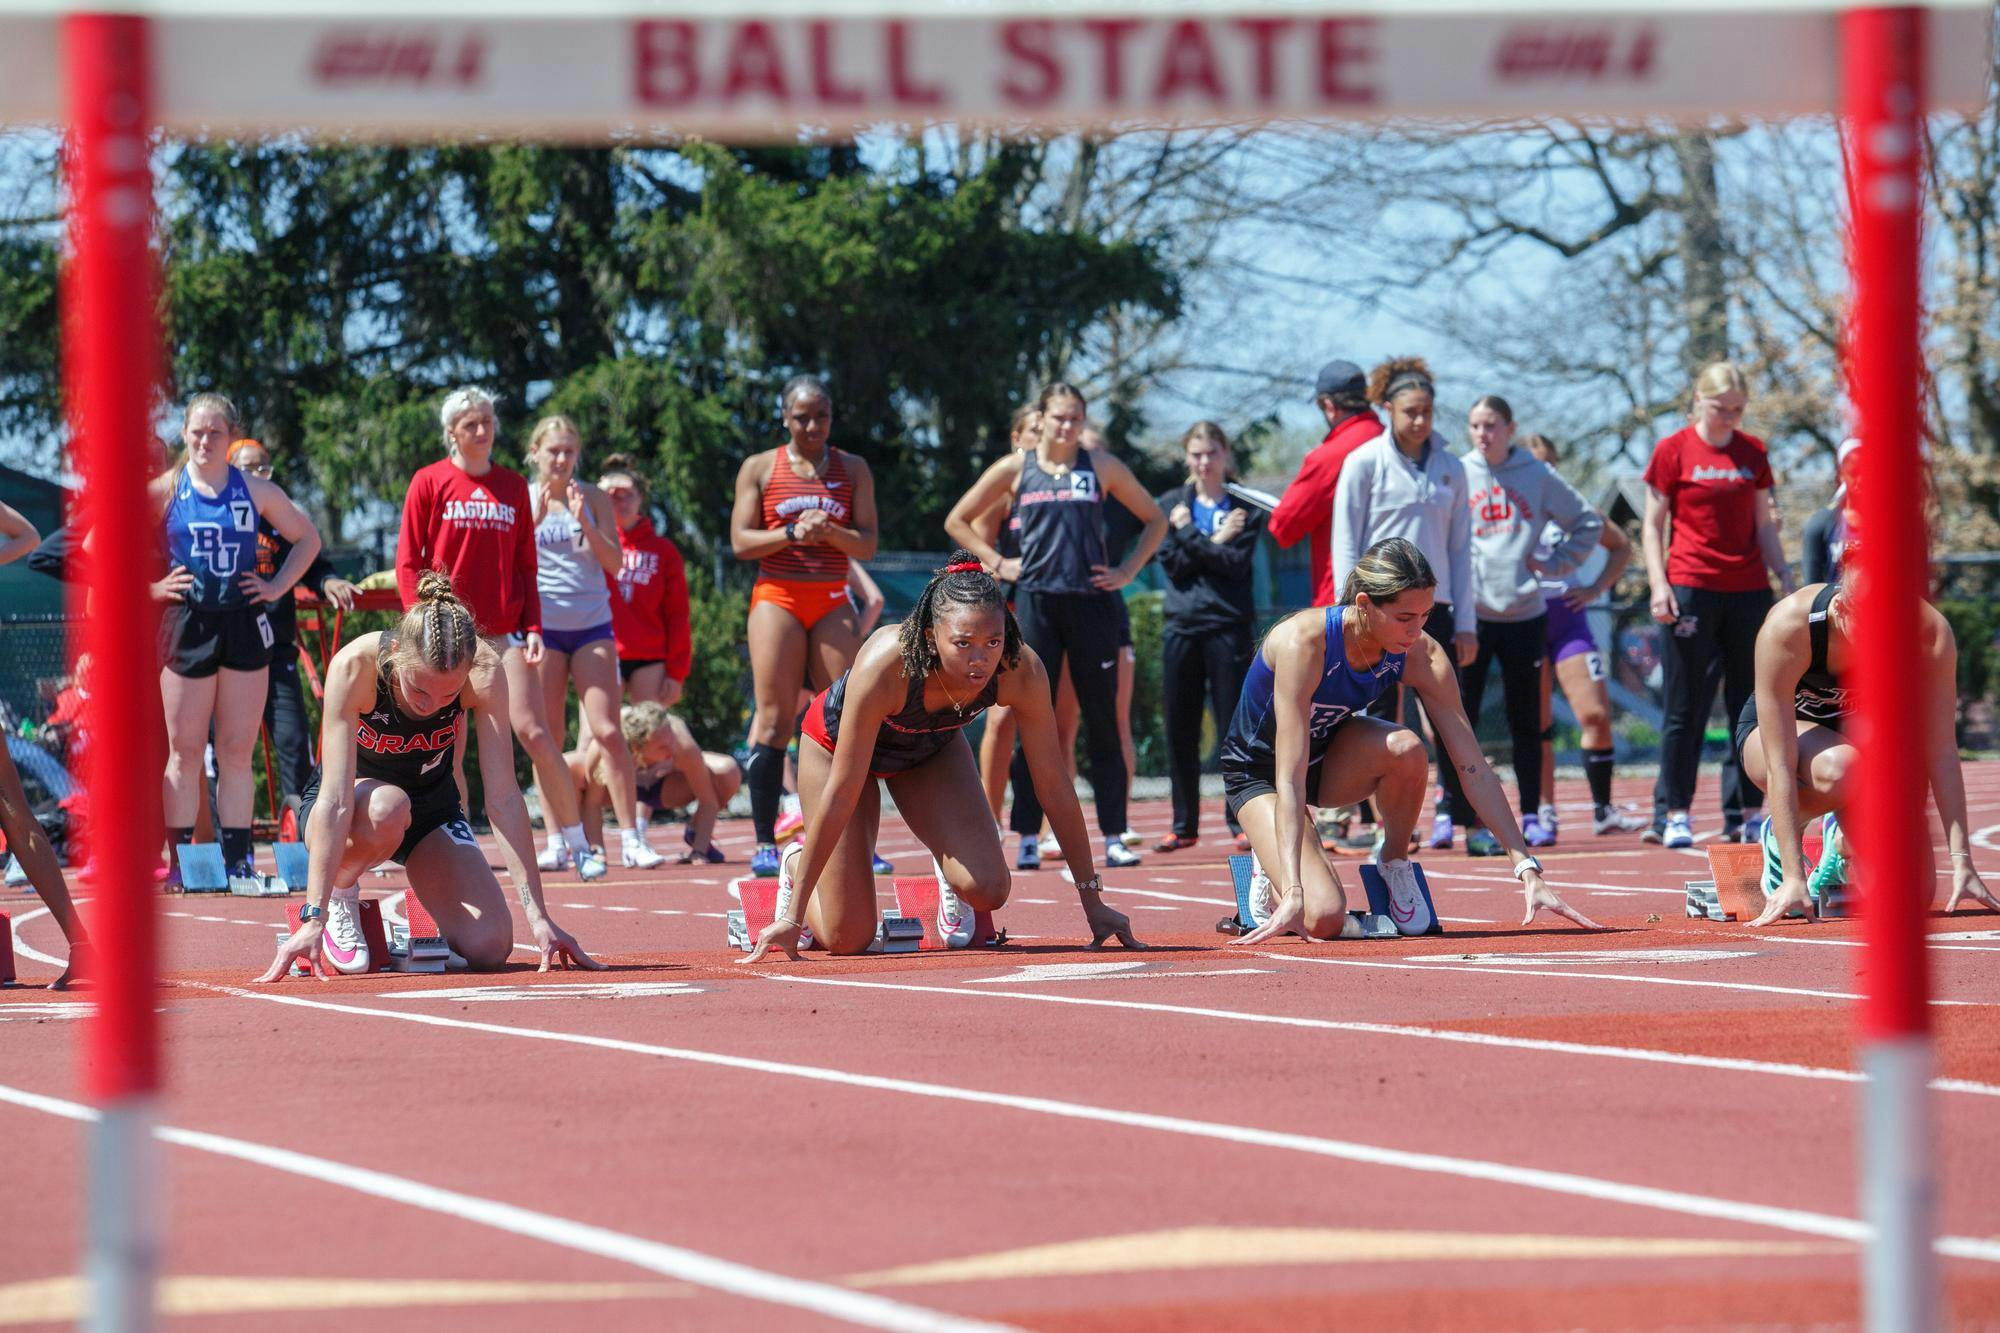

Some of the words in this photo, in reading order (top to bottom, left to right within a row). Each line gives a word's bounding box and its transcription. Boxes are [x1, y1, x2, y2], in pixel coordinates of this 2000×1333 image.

[633, 18, 950, 108] BALL
[997, 17, 1385, 107] STATE
[1075, 476, 1090, 494] 4
[234, 506, 250, 526] 7
[442, 500, 516, 526] JAGUARS
[573, 528, 585, 547] 7
[188, 521, 241, 577] BU
[260, 621, 270, 642] 7
[447, 820, 475, 842] 8
